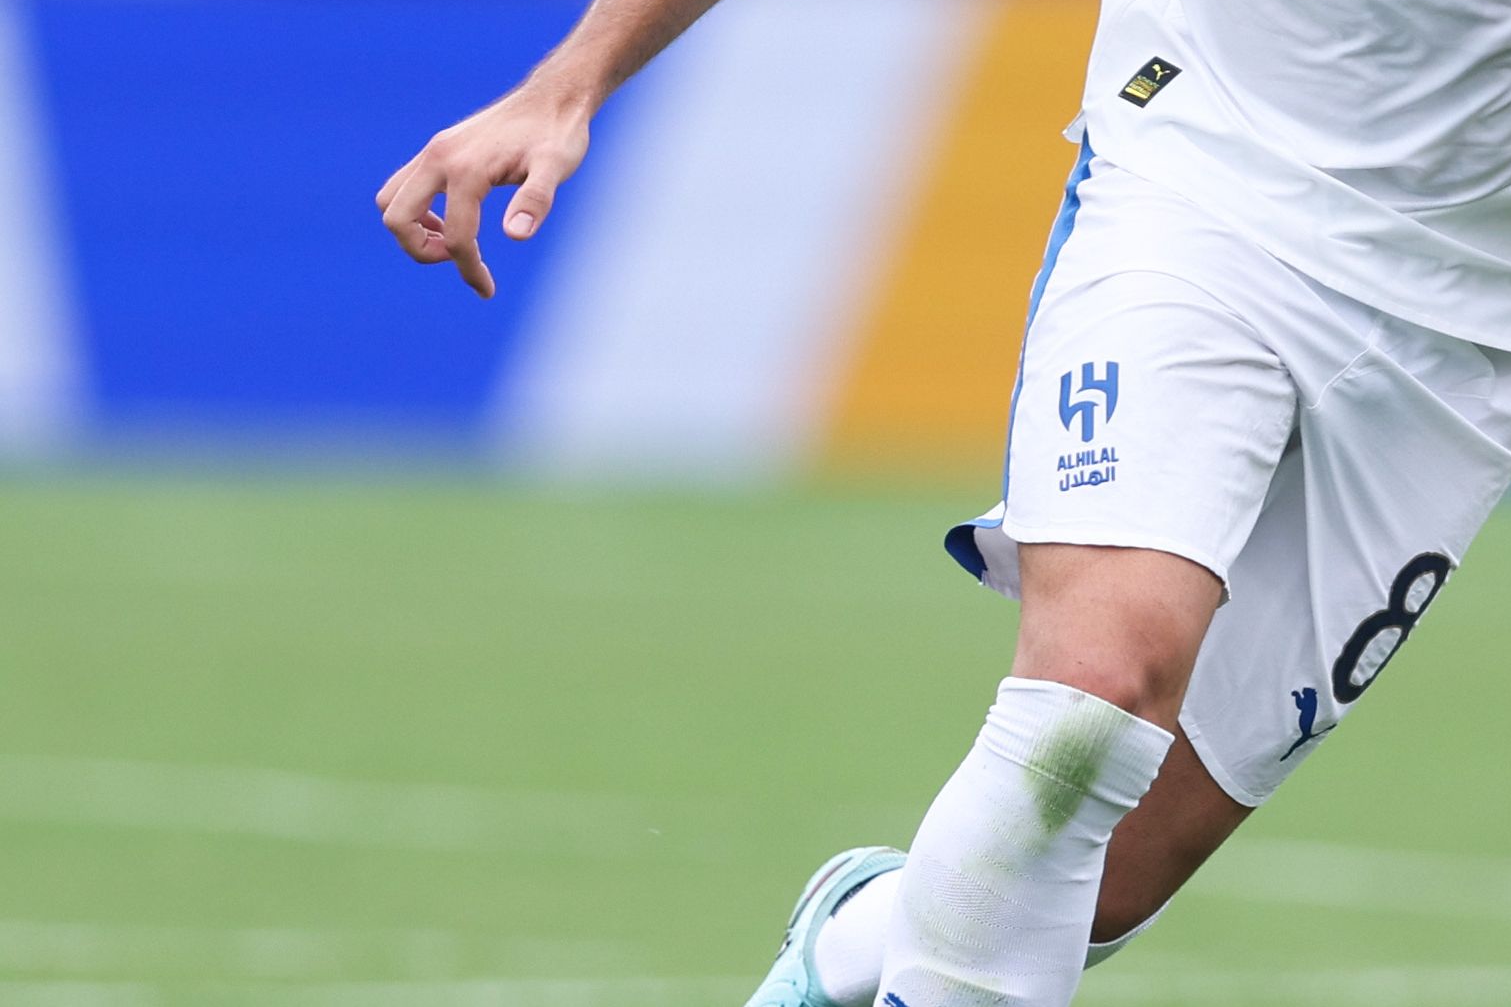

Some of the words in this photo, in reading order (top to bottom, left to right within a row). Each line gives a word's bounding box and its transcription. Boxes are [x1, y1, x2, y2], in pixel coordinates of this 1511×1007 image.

[1057, 447, 1119, 471] ALHILAL
[1060, 466, 1116, 492] الهلال
[1332, 552, 1451, 704] 8
